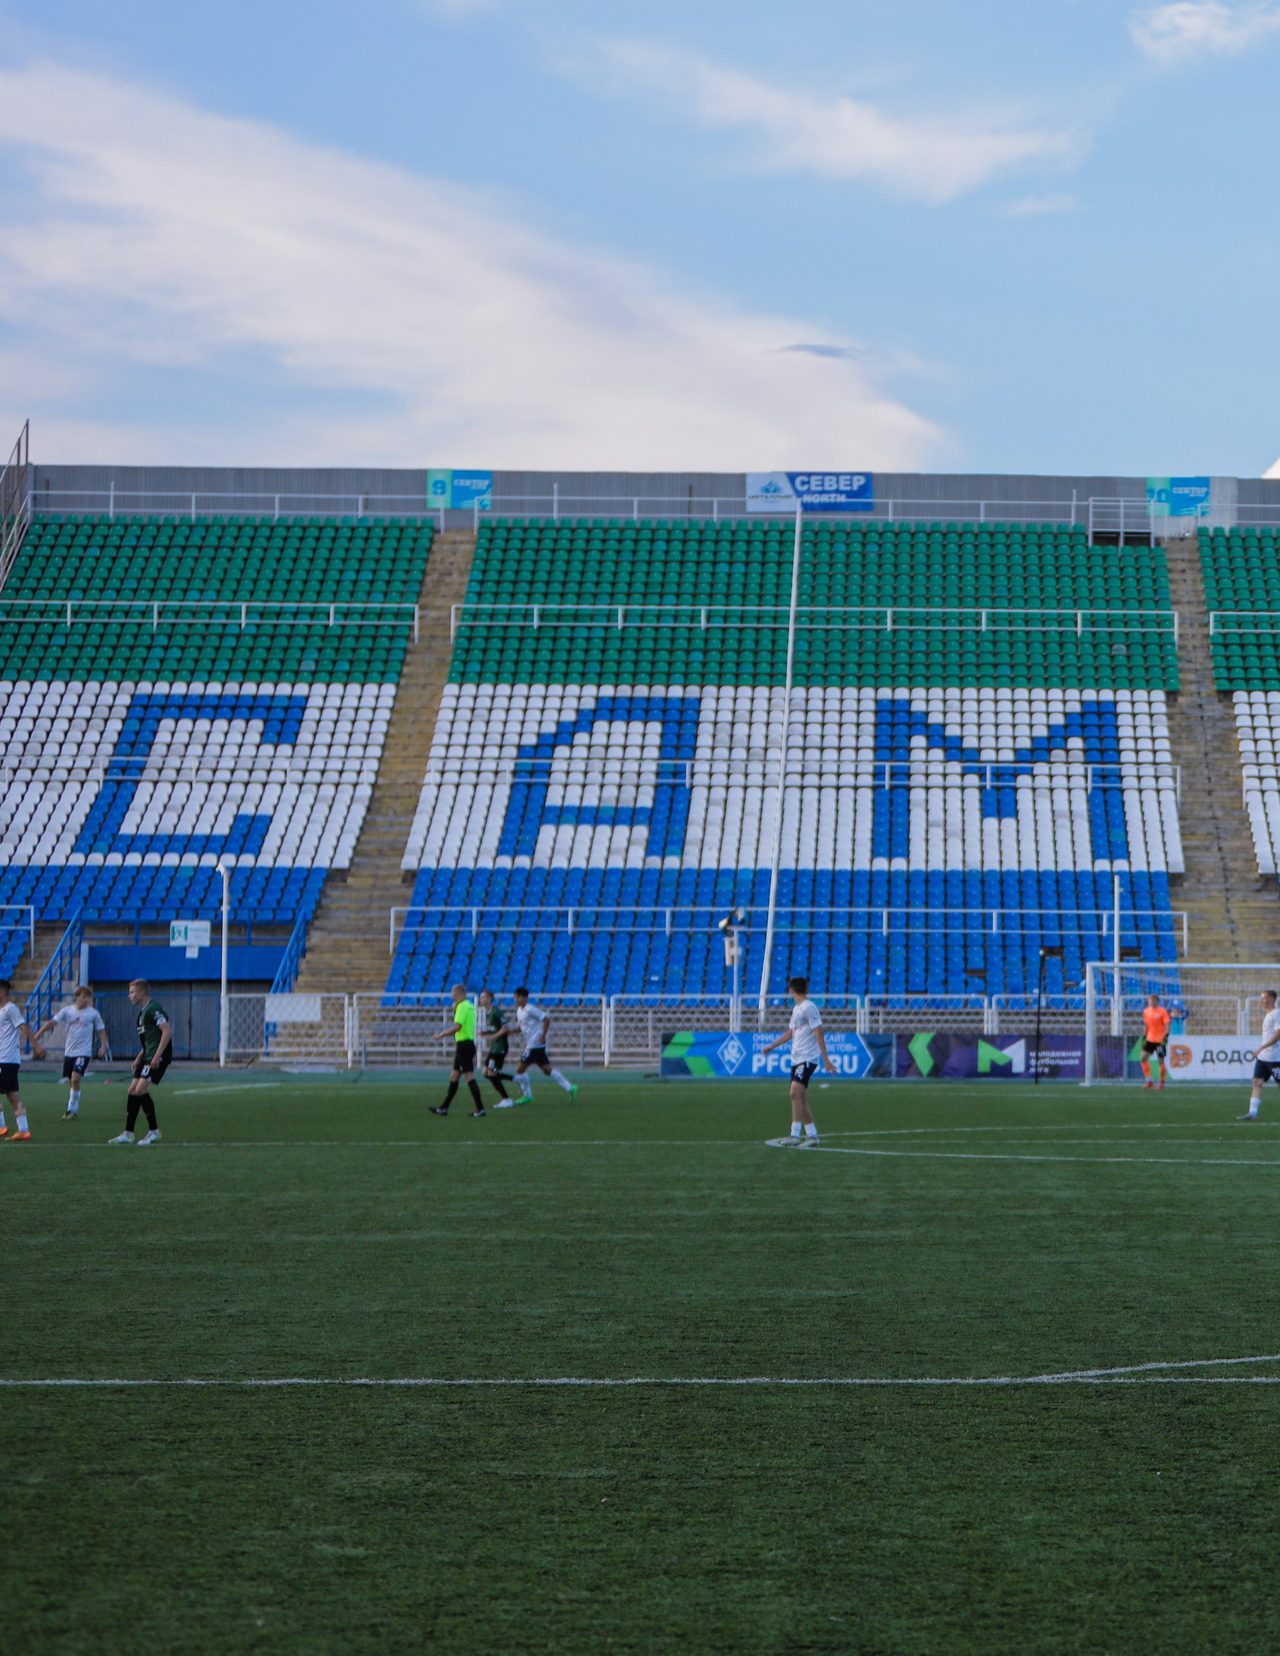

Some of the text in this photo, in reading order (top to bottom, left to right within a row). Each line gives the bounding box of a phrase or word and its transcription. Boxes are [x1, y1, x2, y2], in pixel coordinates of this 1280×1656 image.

[432, 480, 446, 495] 9
[795, 475, 866, 491] СЕВЕР
[802, 493, 847, 504] NORTH
[751, 1054, 859, 1074] PFC.RU
[1201, 1050, 1256, 1065] ДОДО
